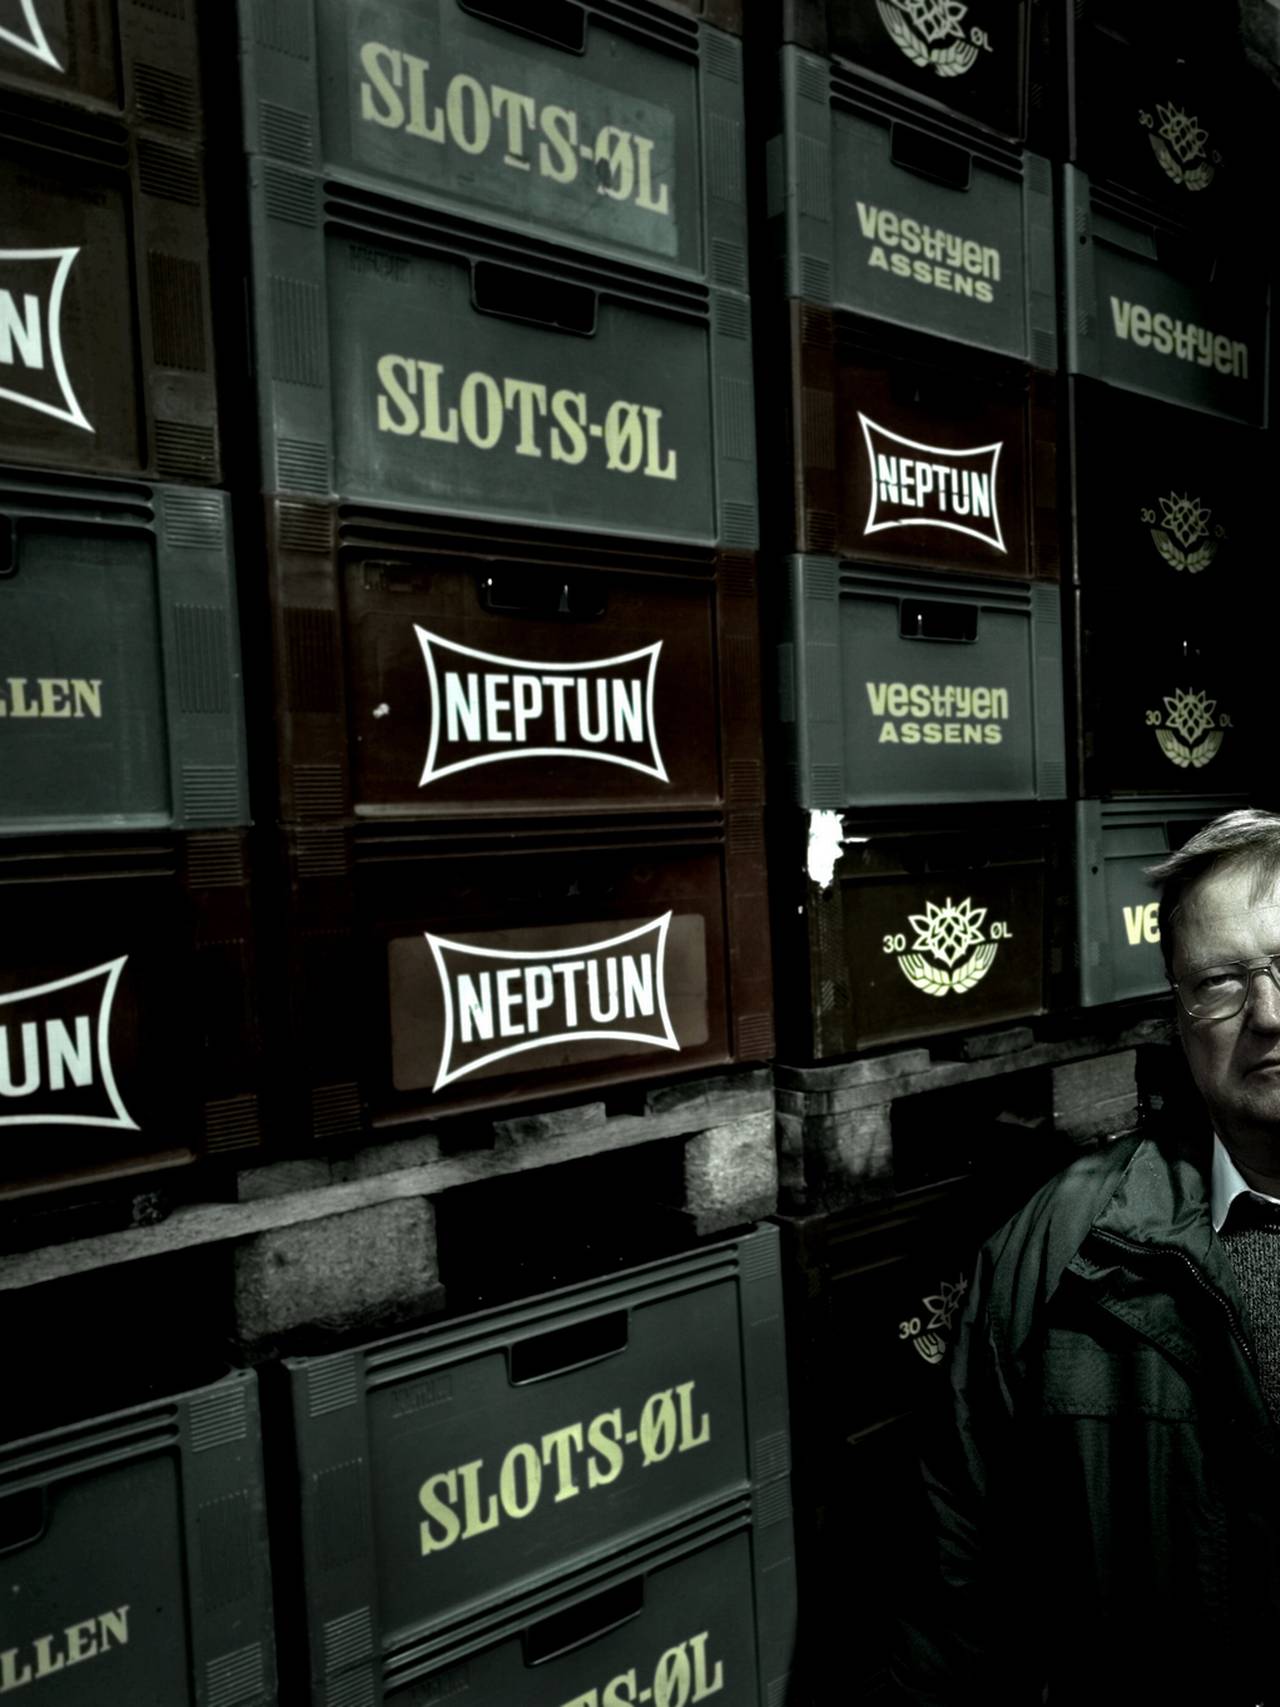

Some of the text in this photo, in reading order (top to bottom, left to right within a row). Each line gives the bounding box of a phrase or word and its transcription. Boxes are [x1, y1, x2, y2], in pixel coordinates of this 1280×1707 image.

[359, 42, 669, 215] SLOTS-ØL
[867, 243, 994, 303] ASSENS
[376, 354, 677, 480] SLOTS-ØL
[877, 453, 992, 519] NEPTUN
[0, 677, 102, 718] LEN
[445, 671, 643, 743] NEPTUN
[1145, 709, 1162, 726] 30
[878, 724, 1003, 744] ASSENS
[882, 933, 906, 953] 30
[458, 954, 655, 1043] NEPTUN
[898, 1316, 921, 1340] 30
[418, 1380, 710, 1557] SLOTS-ØL
